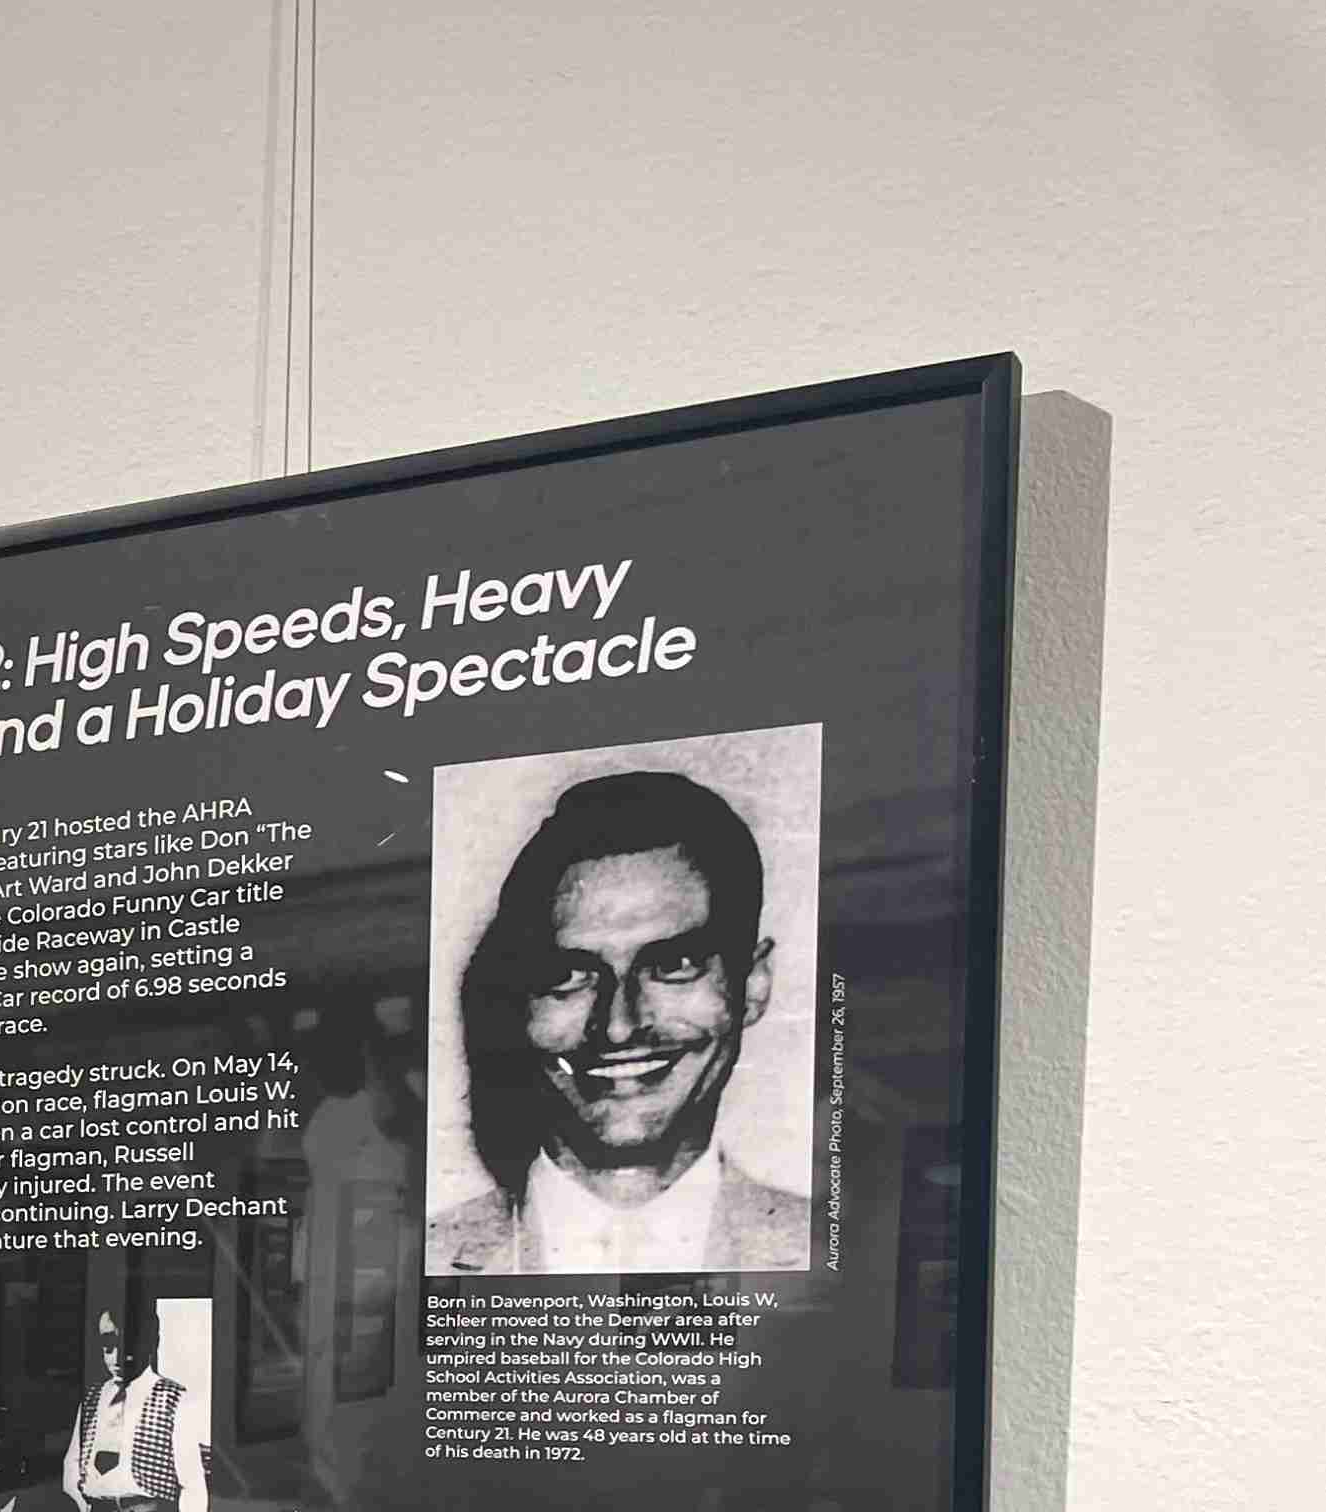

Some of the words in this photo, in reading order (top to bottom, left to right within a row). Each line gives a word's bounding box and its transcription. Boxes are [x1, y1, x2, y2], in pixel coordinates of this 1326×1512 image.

[24, 622, 149, 691] High
[163, 586, 407, 674] Speeds,
[420, 559, 633, 630] Heavy
[76, 705, 114, 745] a
[125, 669, 352, 740] Holiday
[361, 615, 696, 717] Spectacle
[27, 820, 47, 840] 21
[54, 809, 131, 837] hosted
[137, 807, 176, 828] the
[181, 797, 252, 823] AHRA
[92, 841, 148, 861] stars
[154, 833, 193, 855] like
[201, 830, 248, 850] Don
[831, 973, 845, 1003] 1957
[831, 1006, 845, 1026] 26,
[829, 1027, 844, 1105] September
[828, 1108, 844, 1152] Photo,
[827, 1155, 841, 1221] Advocate
[826, 1222, 840, 1271] Aurora
[427, 1295, 466, 1309] Born
[470, 1295, 486, 1308] in
[490, 1295, 583, 1310] Davenport,
[587, 1293, 698, 1310] Washington,
[702, 1292, 750, 1307] Louis
